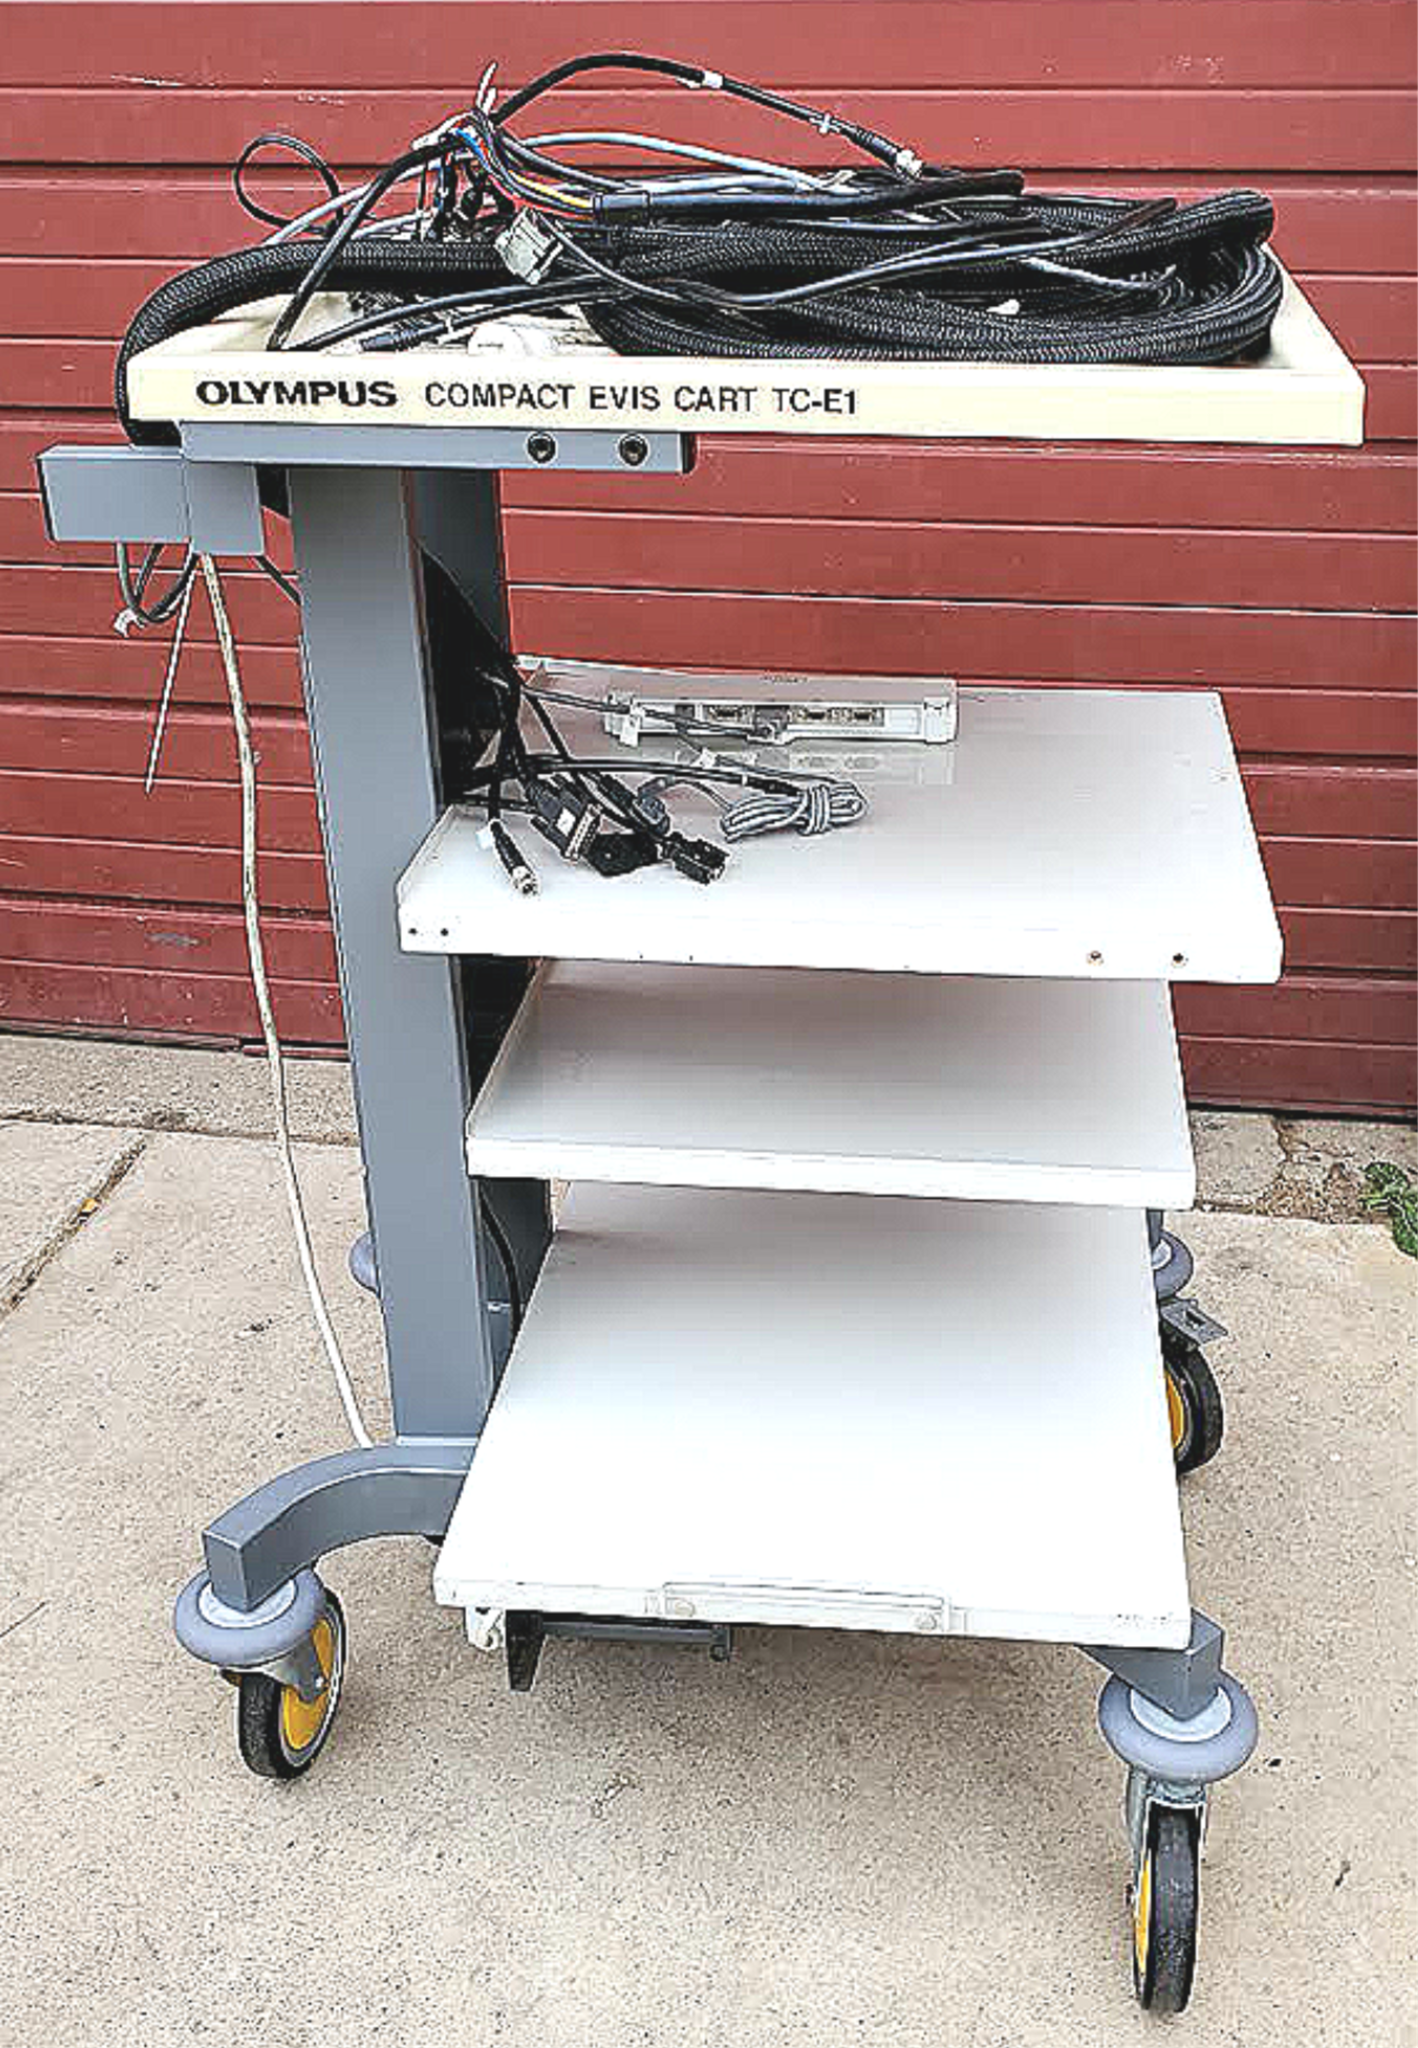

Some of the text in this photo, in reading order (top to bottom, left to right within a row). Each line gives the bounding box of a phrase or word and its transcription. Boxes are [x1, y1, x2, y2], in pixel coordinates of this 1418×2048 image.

[196, 380, 854, 414] OLYMPUS COMPACT EVIS CART TC-E1
